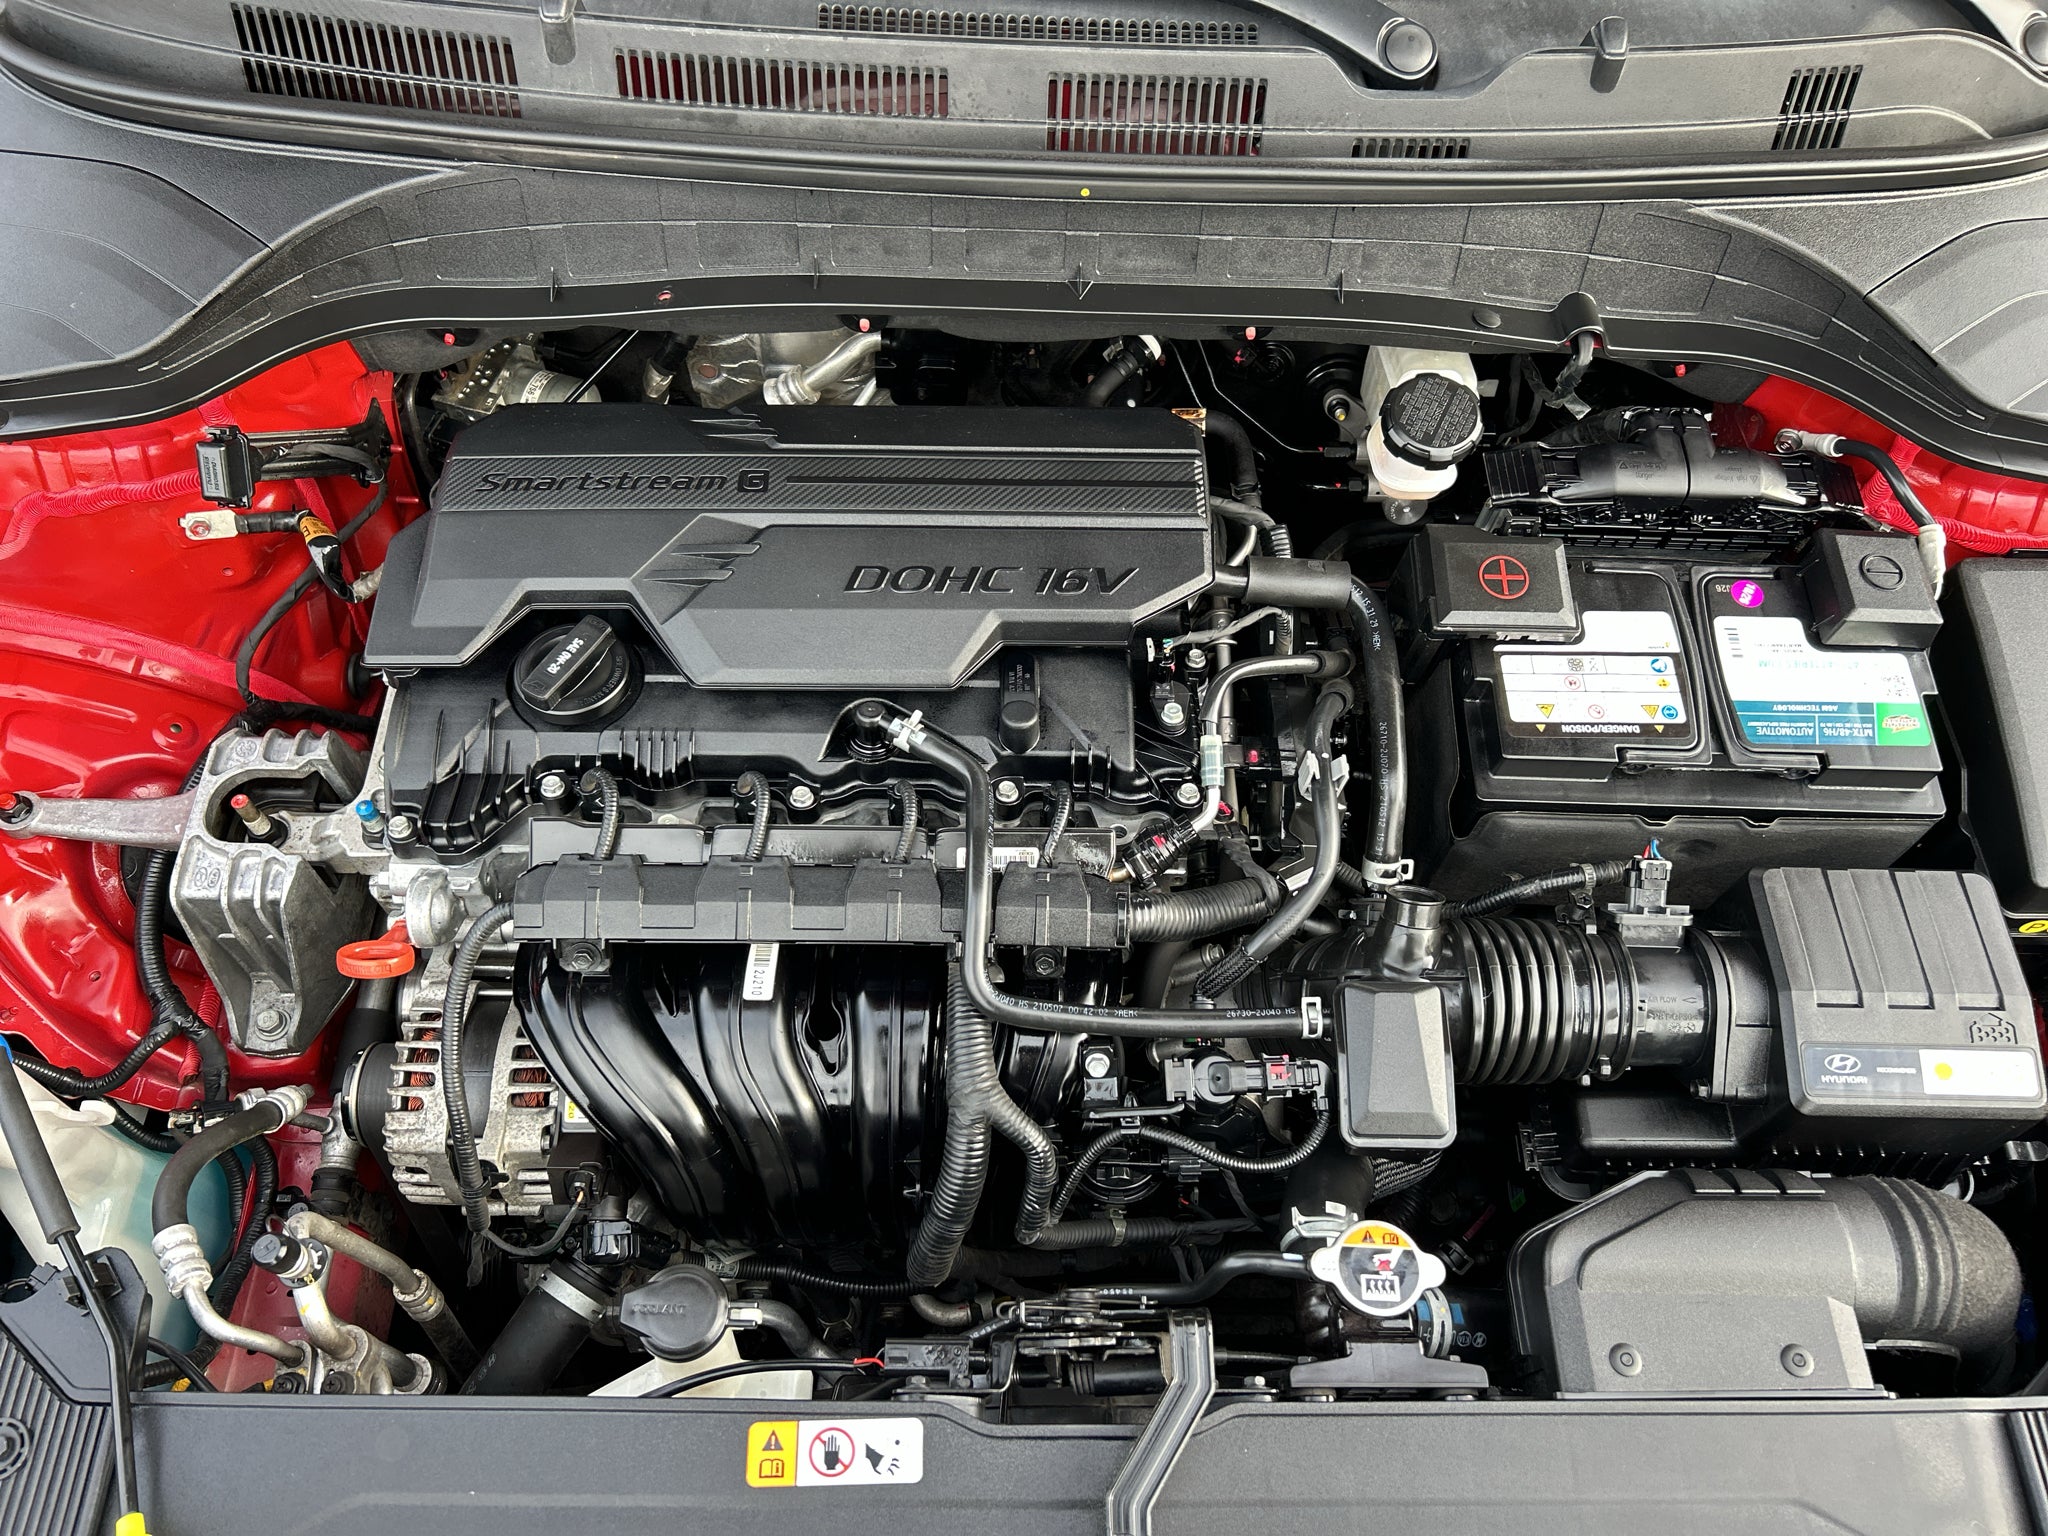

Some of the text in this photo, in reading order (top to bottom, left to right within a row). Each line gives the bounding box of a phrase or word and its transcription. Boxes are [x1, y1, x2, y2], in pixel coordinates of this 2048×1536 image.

[475, 471, 728, 492] Smartstream
[844, 565, 1139, 595] DOHC 16V
[567, 637, 584, 653] SAE
[1561, 724, 1640, 734] DANGER/POISON
[1756, 726, 1814, 735] AUTOMOTIVE
[752, 969, 765, 996] 2J210
[1821, 1075, 1868, 1084] HYUNDAI
